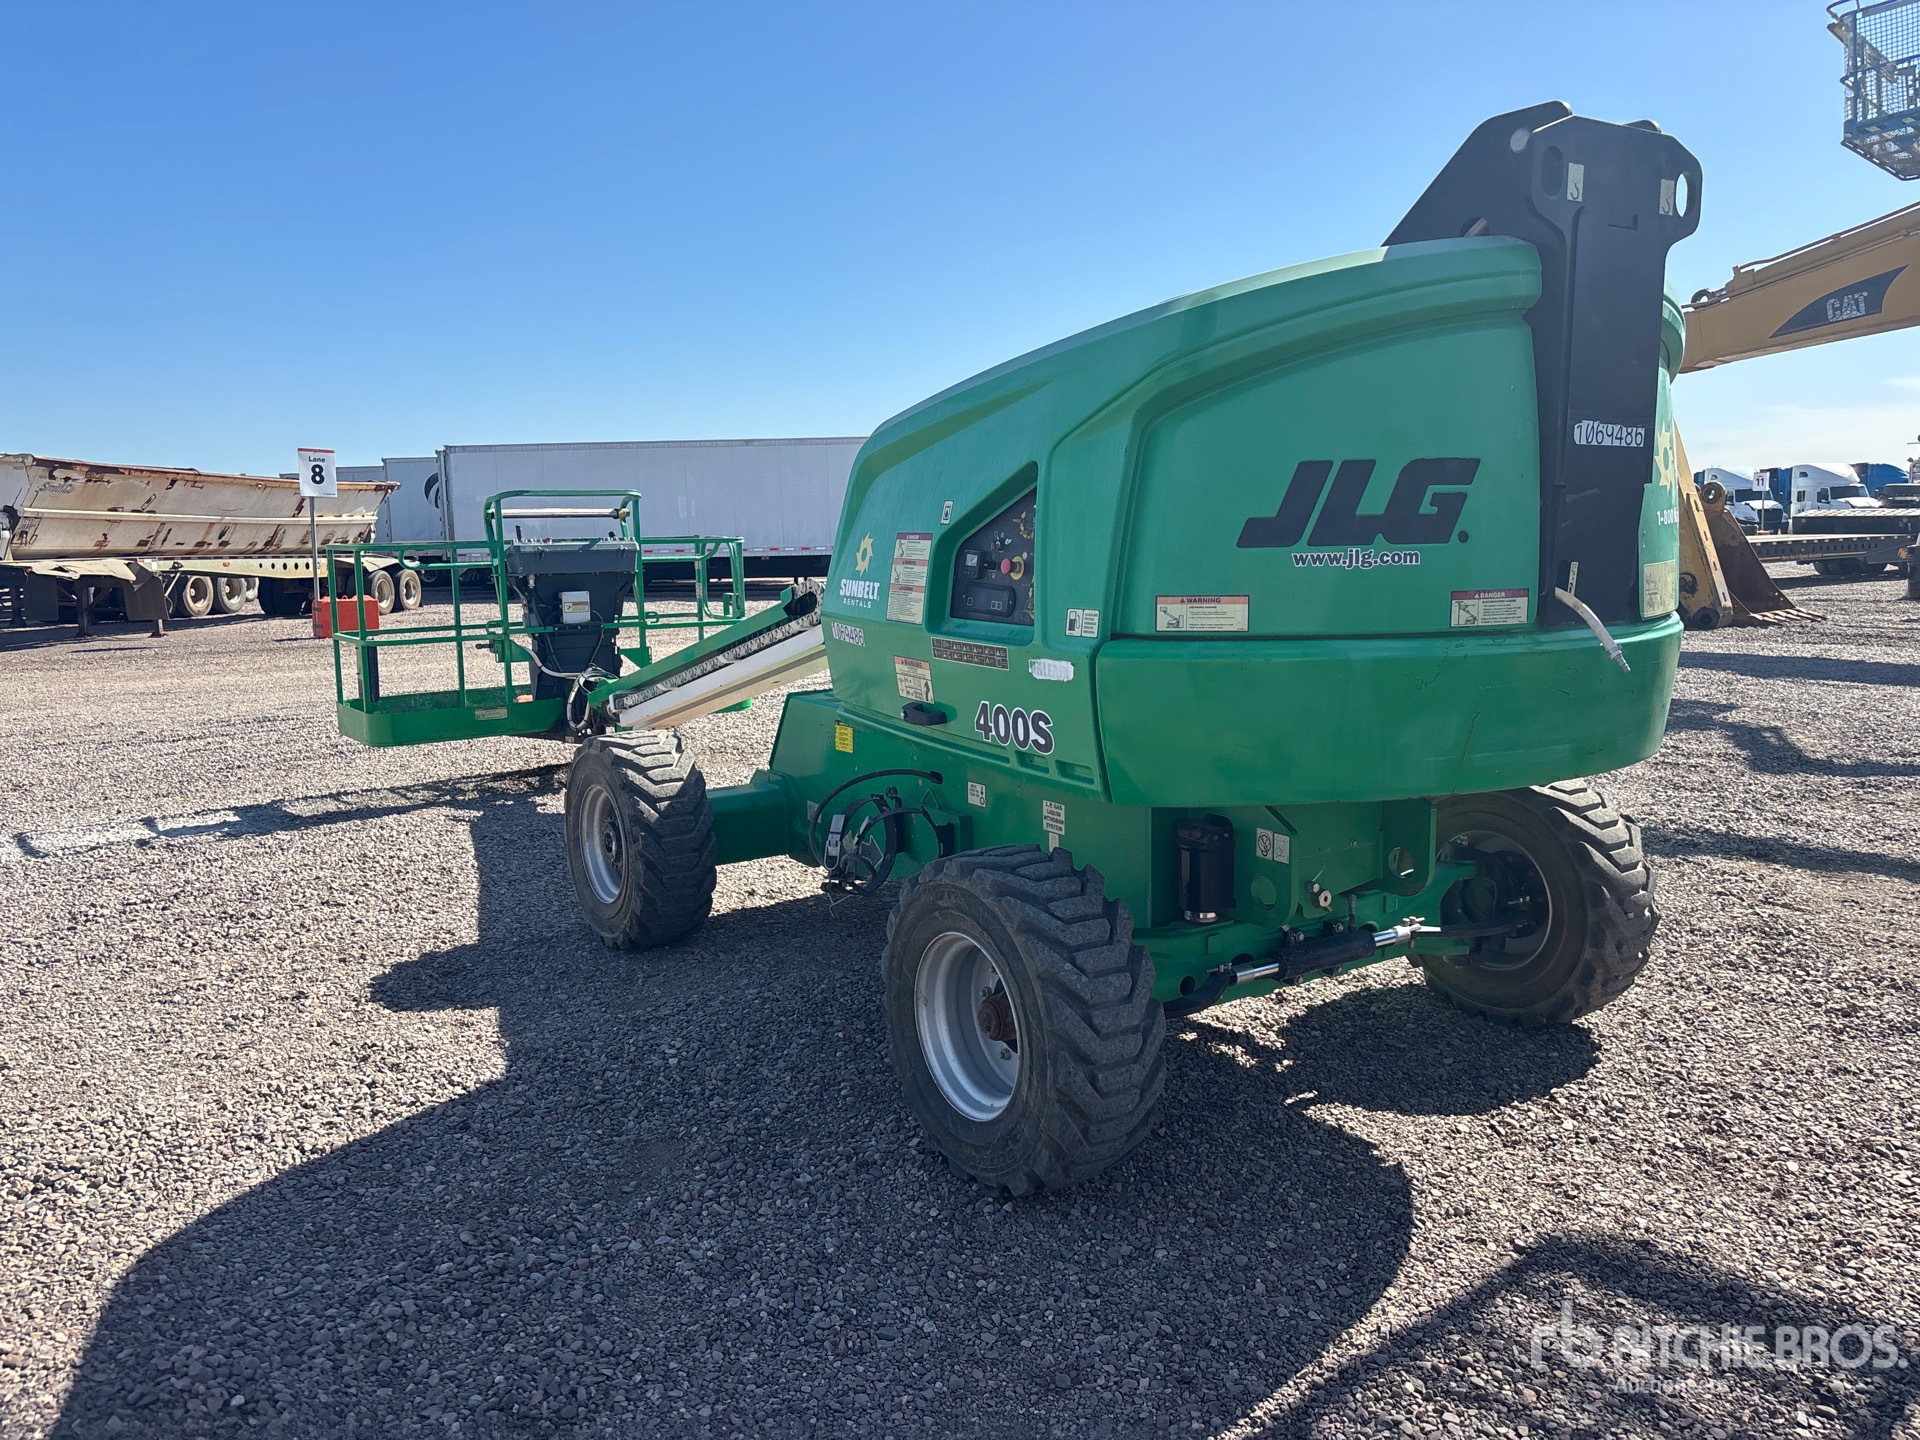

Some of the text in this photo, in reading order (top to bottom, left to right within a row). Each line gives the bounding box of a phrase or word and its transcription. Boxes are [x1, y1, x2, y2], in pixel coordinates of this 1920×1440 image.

[1826, 291, 1868, 322] CAT
[1575, 420, 1644, 447] 1069486
[311, 464, 325, 485] 8
[1755, 477, 1765, 487] 11
[1291, 548, 1421, 570] www.jlg.com
[839, 578, 881, 601] SUNBELT
[842, 597, 872, 609] RENTALS
[974, 700, 1055, 756] 400S
[1046, 808, 1062, 817] LIQUID
[1053, 803, 1063, 811] GAS
[1045, 822, 1063, 832] SYSTEM
